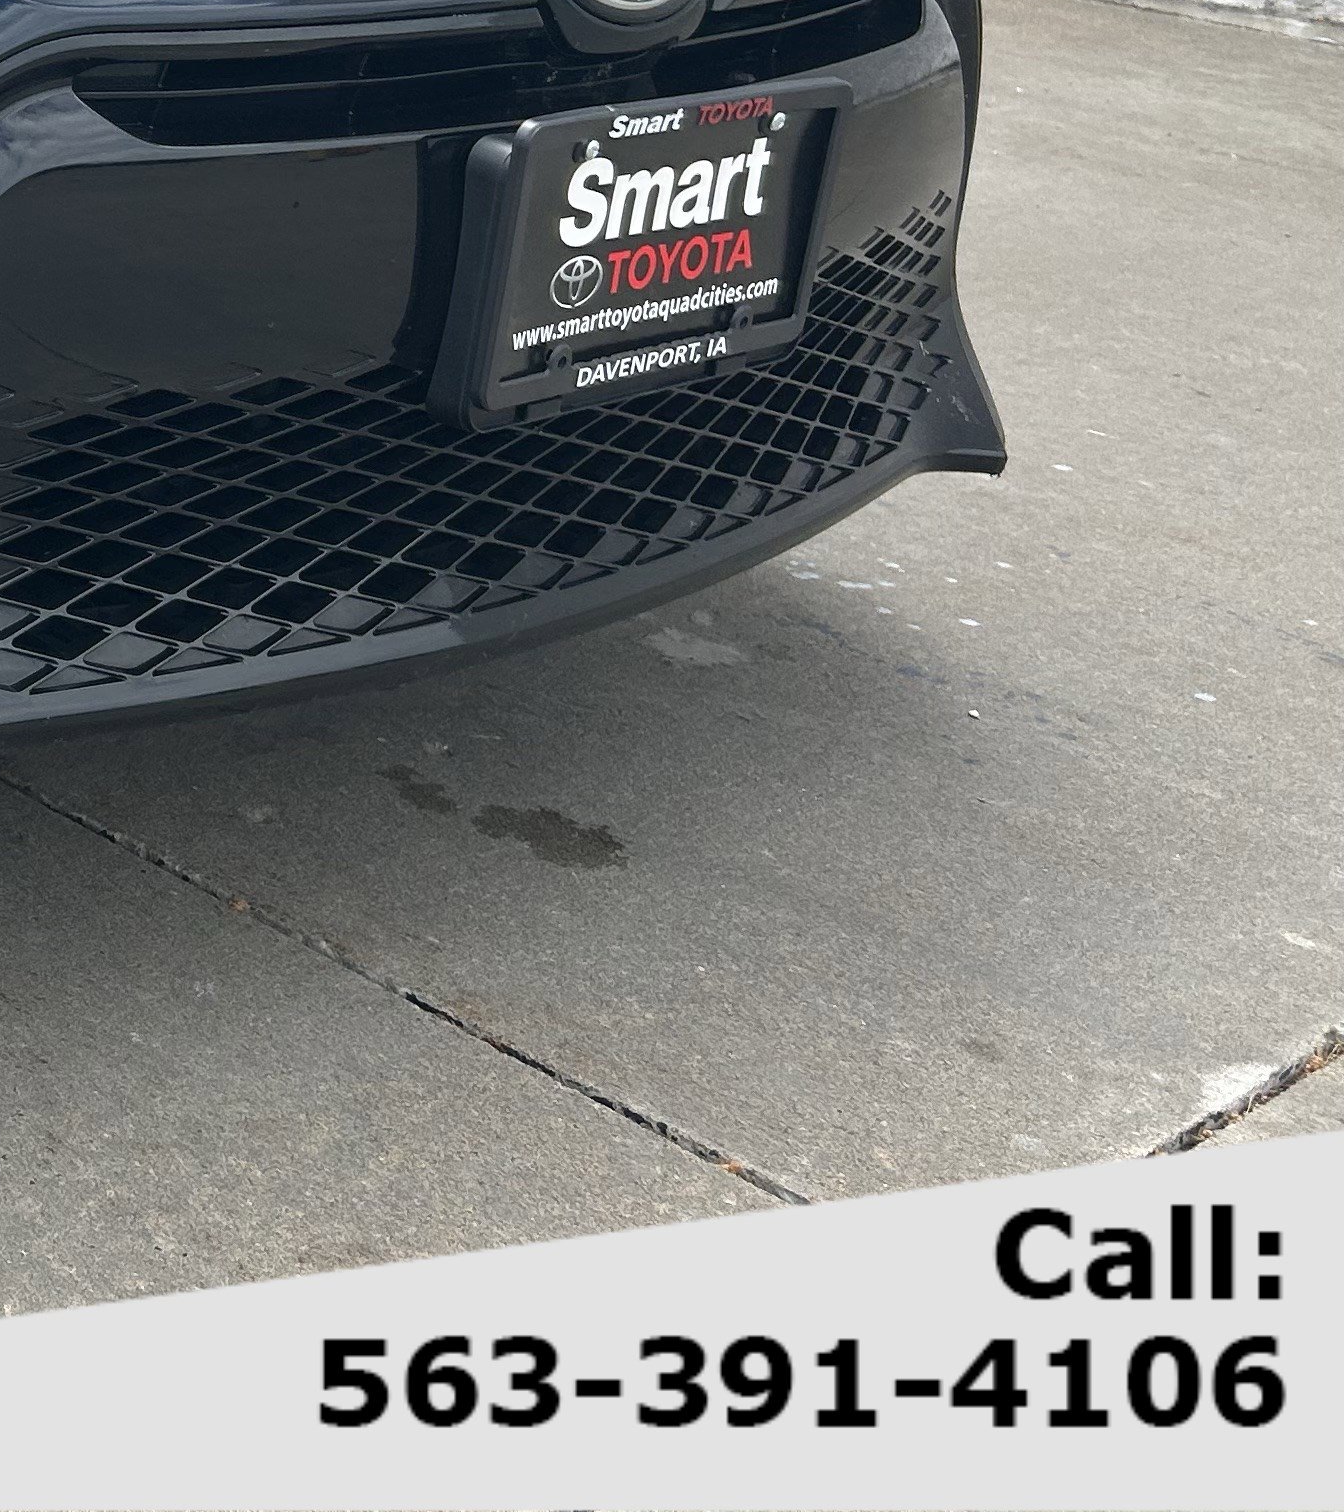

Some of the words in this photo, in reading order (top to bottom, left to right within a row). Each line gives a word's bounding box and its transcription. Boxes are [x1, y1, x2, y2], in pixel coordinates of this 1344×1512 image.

[609, 107, 684, 139] Smart
[698, 95, 774, 126] TOYOTA
[559, 137, 771, 248] Smart
[607, 229, 752, 294] TOYOTA
[512, 277, 779, 351] www.smarttoyotaquadcities.com
[576, 341, 702, 388] DAVENPORT,
[706, 336, 728, 358] IA
